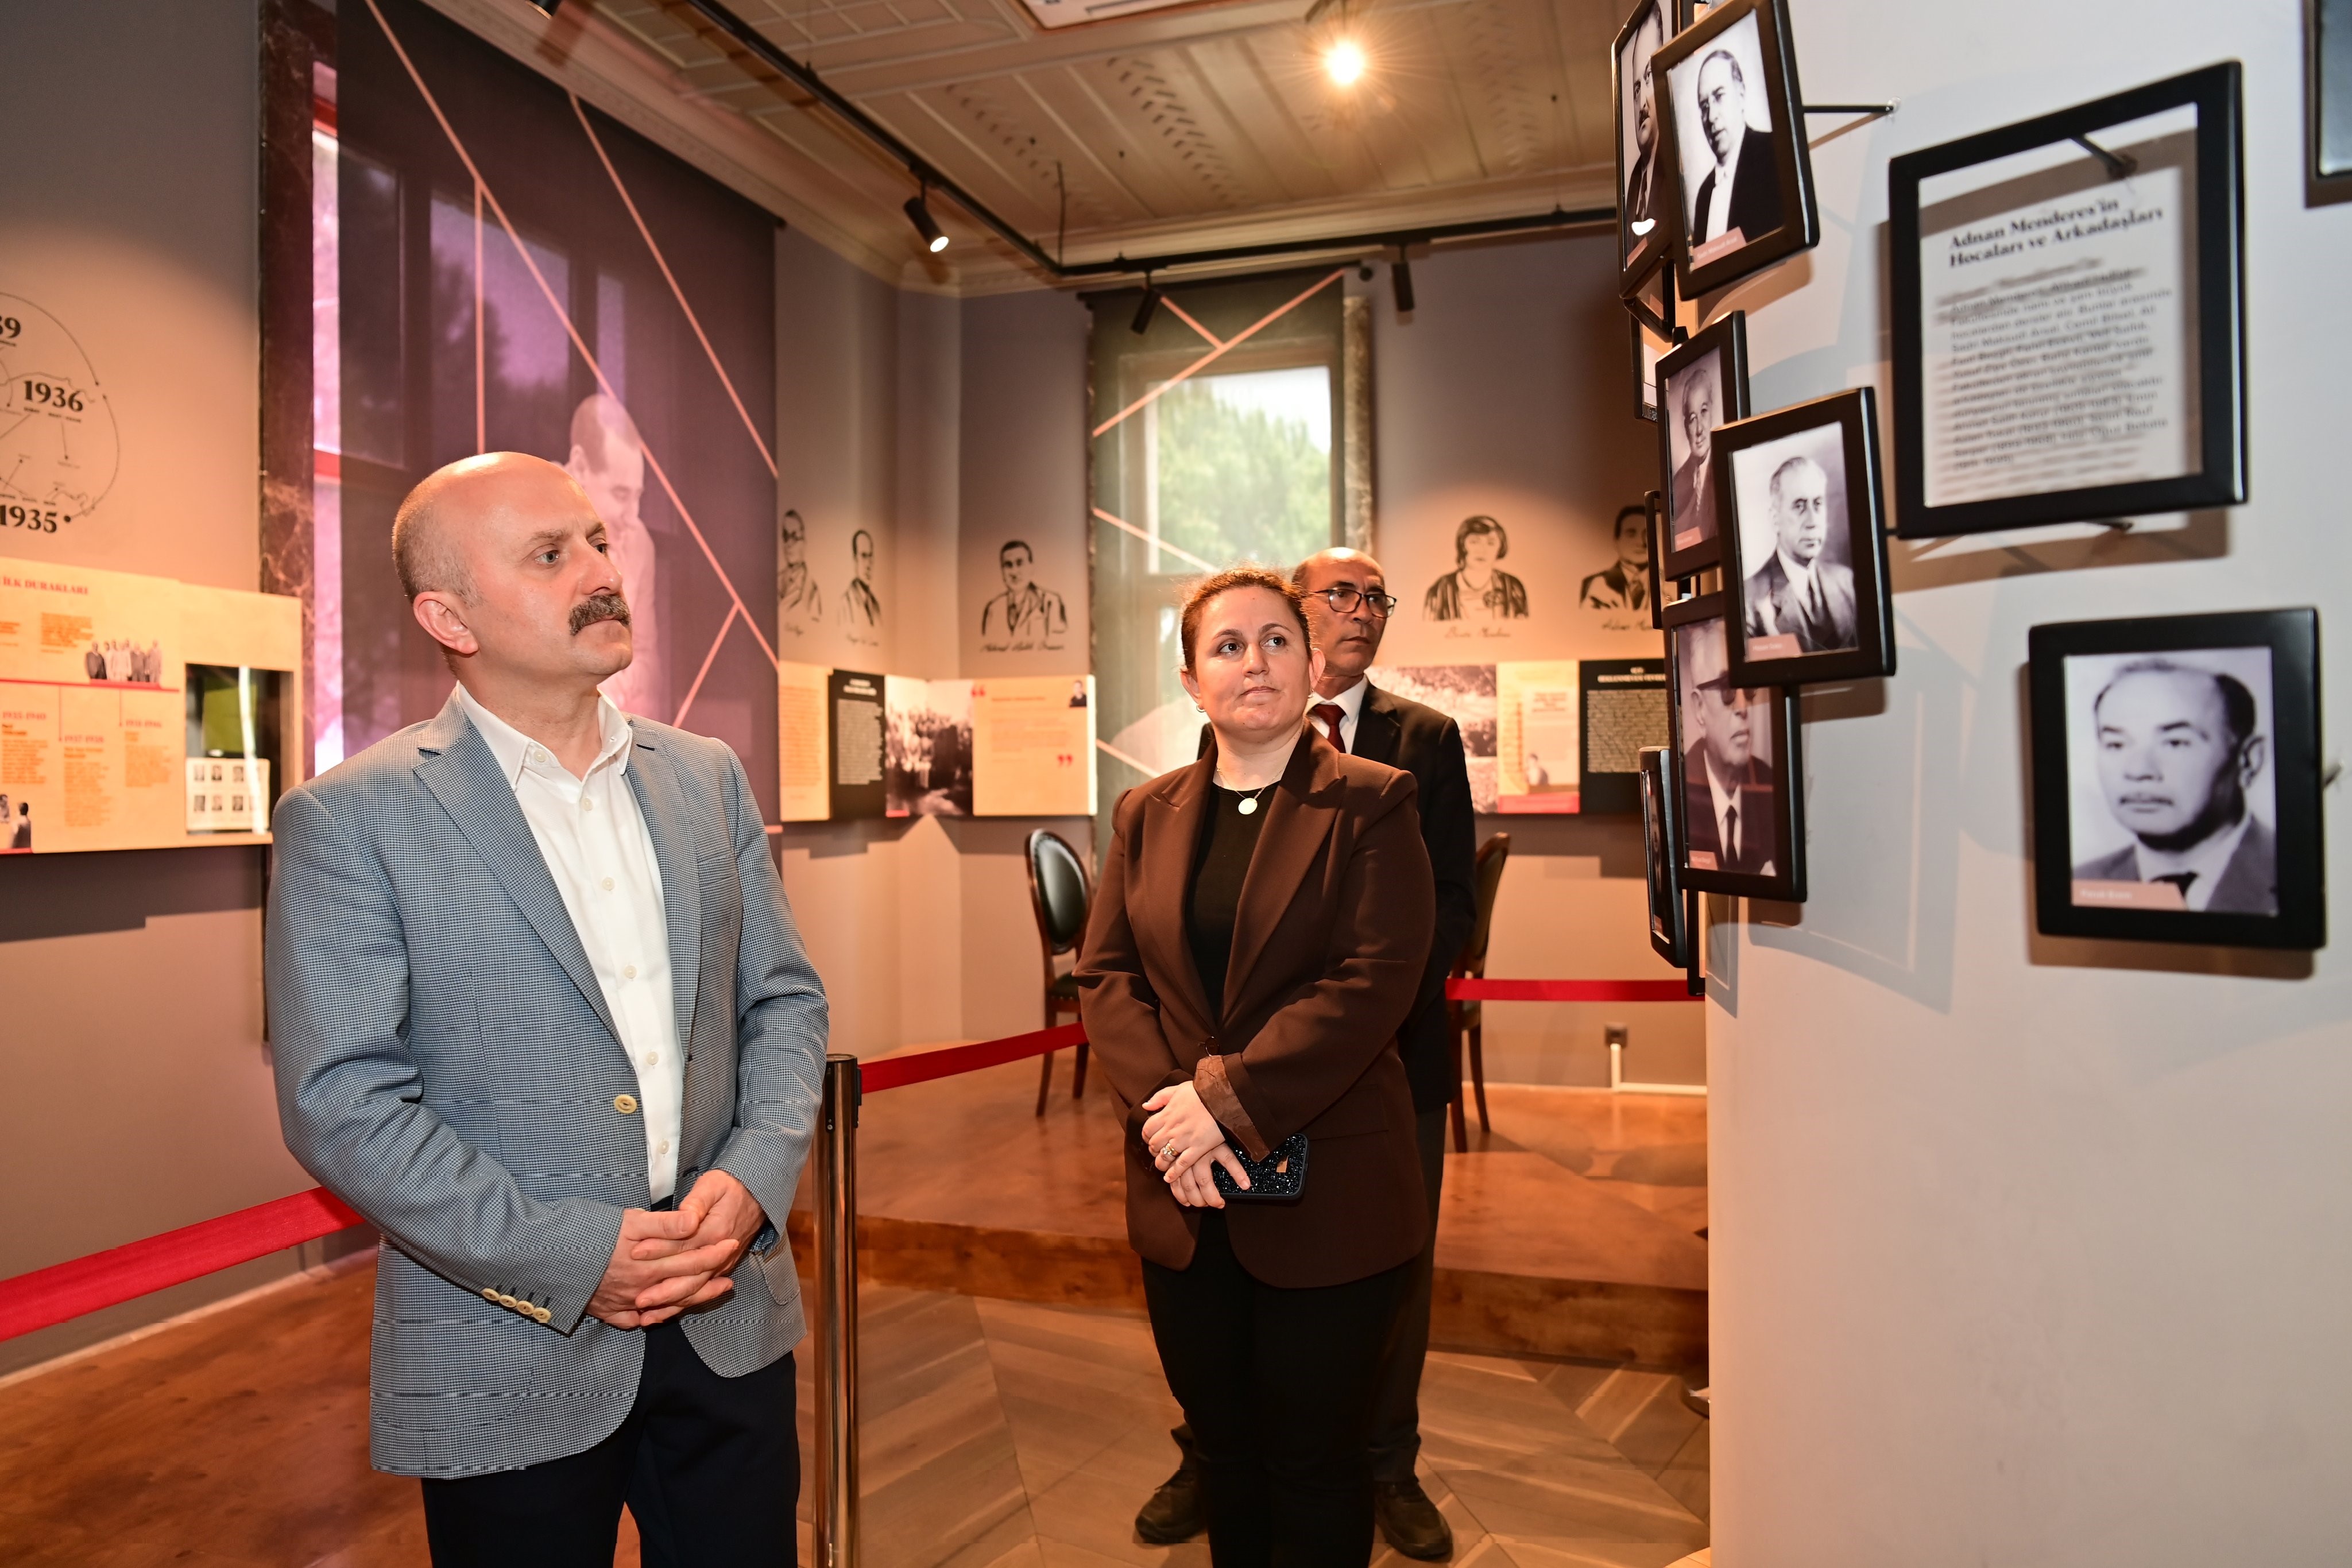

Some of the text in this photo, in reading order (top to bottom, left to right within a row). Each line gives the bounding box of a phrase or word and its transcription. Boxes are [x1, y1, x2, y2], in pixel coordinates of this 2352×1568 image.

[1949, 207, 2163, 268] Hocaları ve Arkadaşları
[1950, 228, 2005, 249] Adnan
[0, 314, 21, 339] 9
[24, 380, 83, 412] 1936
[0, 504, 57, 534] 1935
